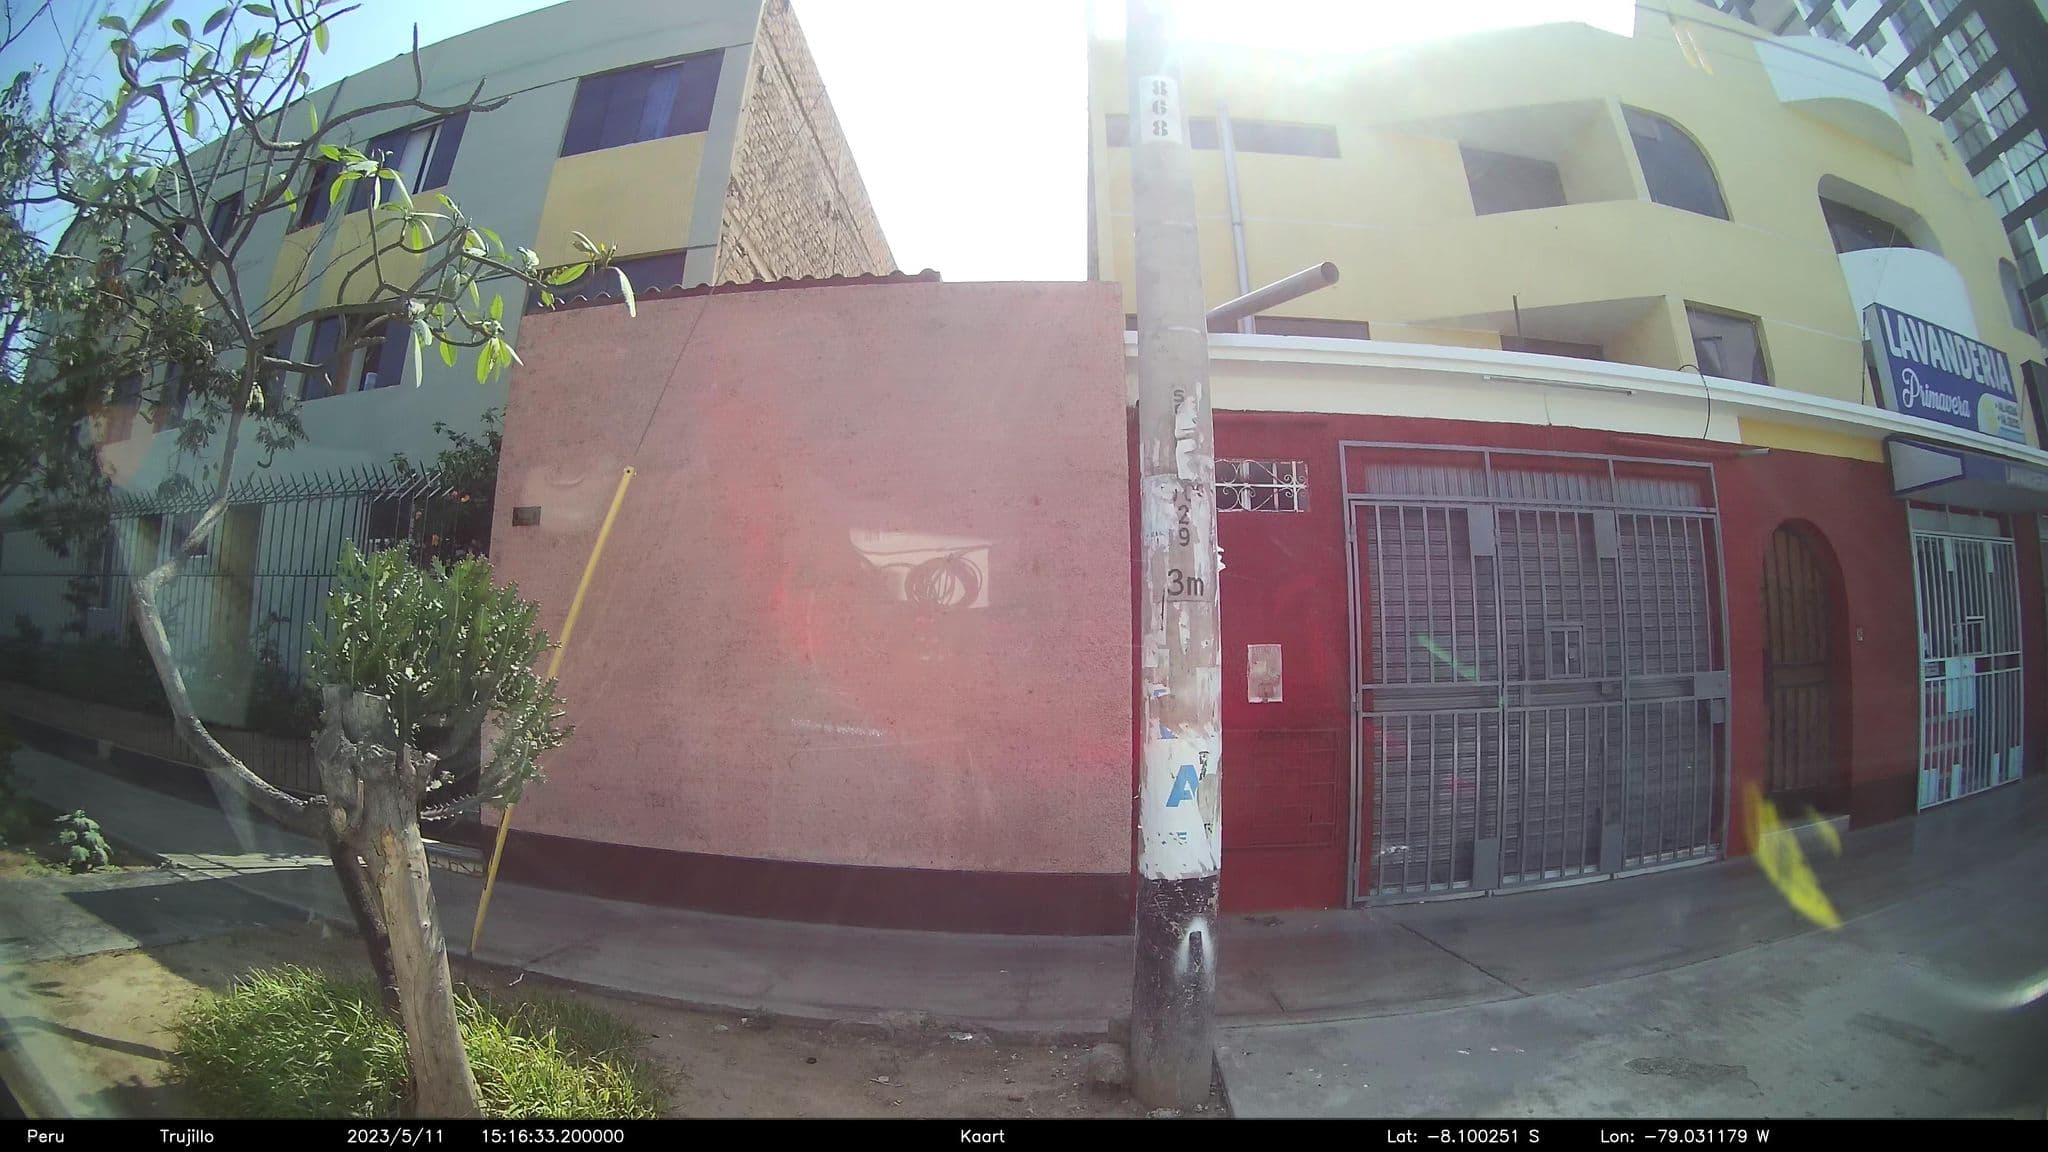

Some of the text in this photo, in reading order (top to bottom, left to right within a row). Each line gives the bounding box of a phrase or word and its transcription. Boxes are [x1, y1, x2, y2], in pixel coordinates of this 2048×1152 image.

[1152, 80, 1168, 136] 868
[1881, 308, 2013, 395] LAVANDERIA
[1902, 367, 1971, 418] Primavera
[1167, 568, 1204, 596] 3m
